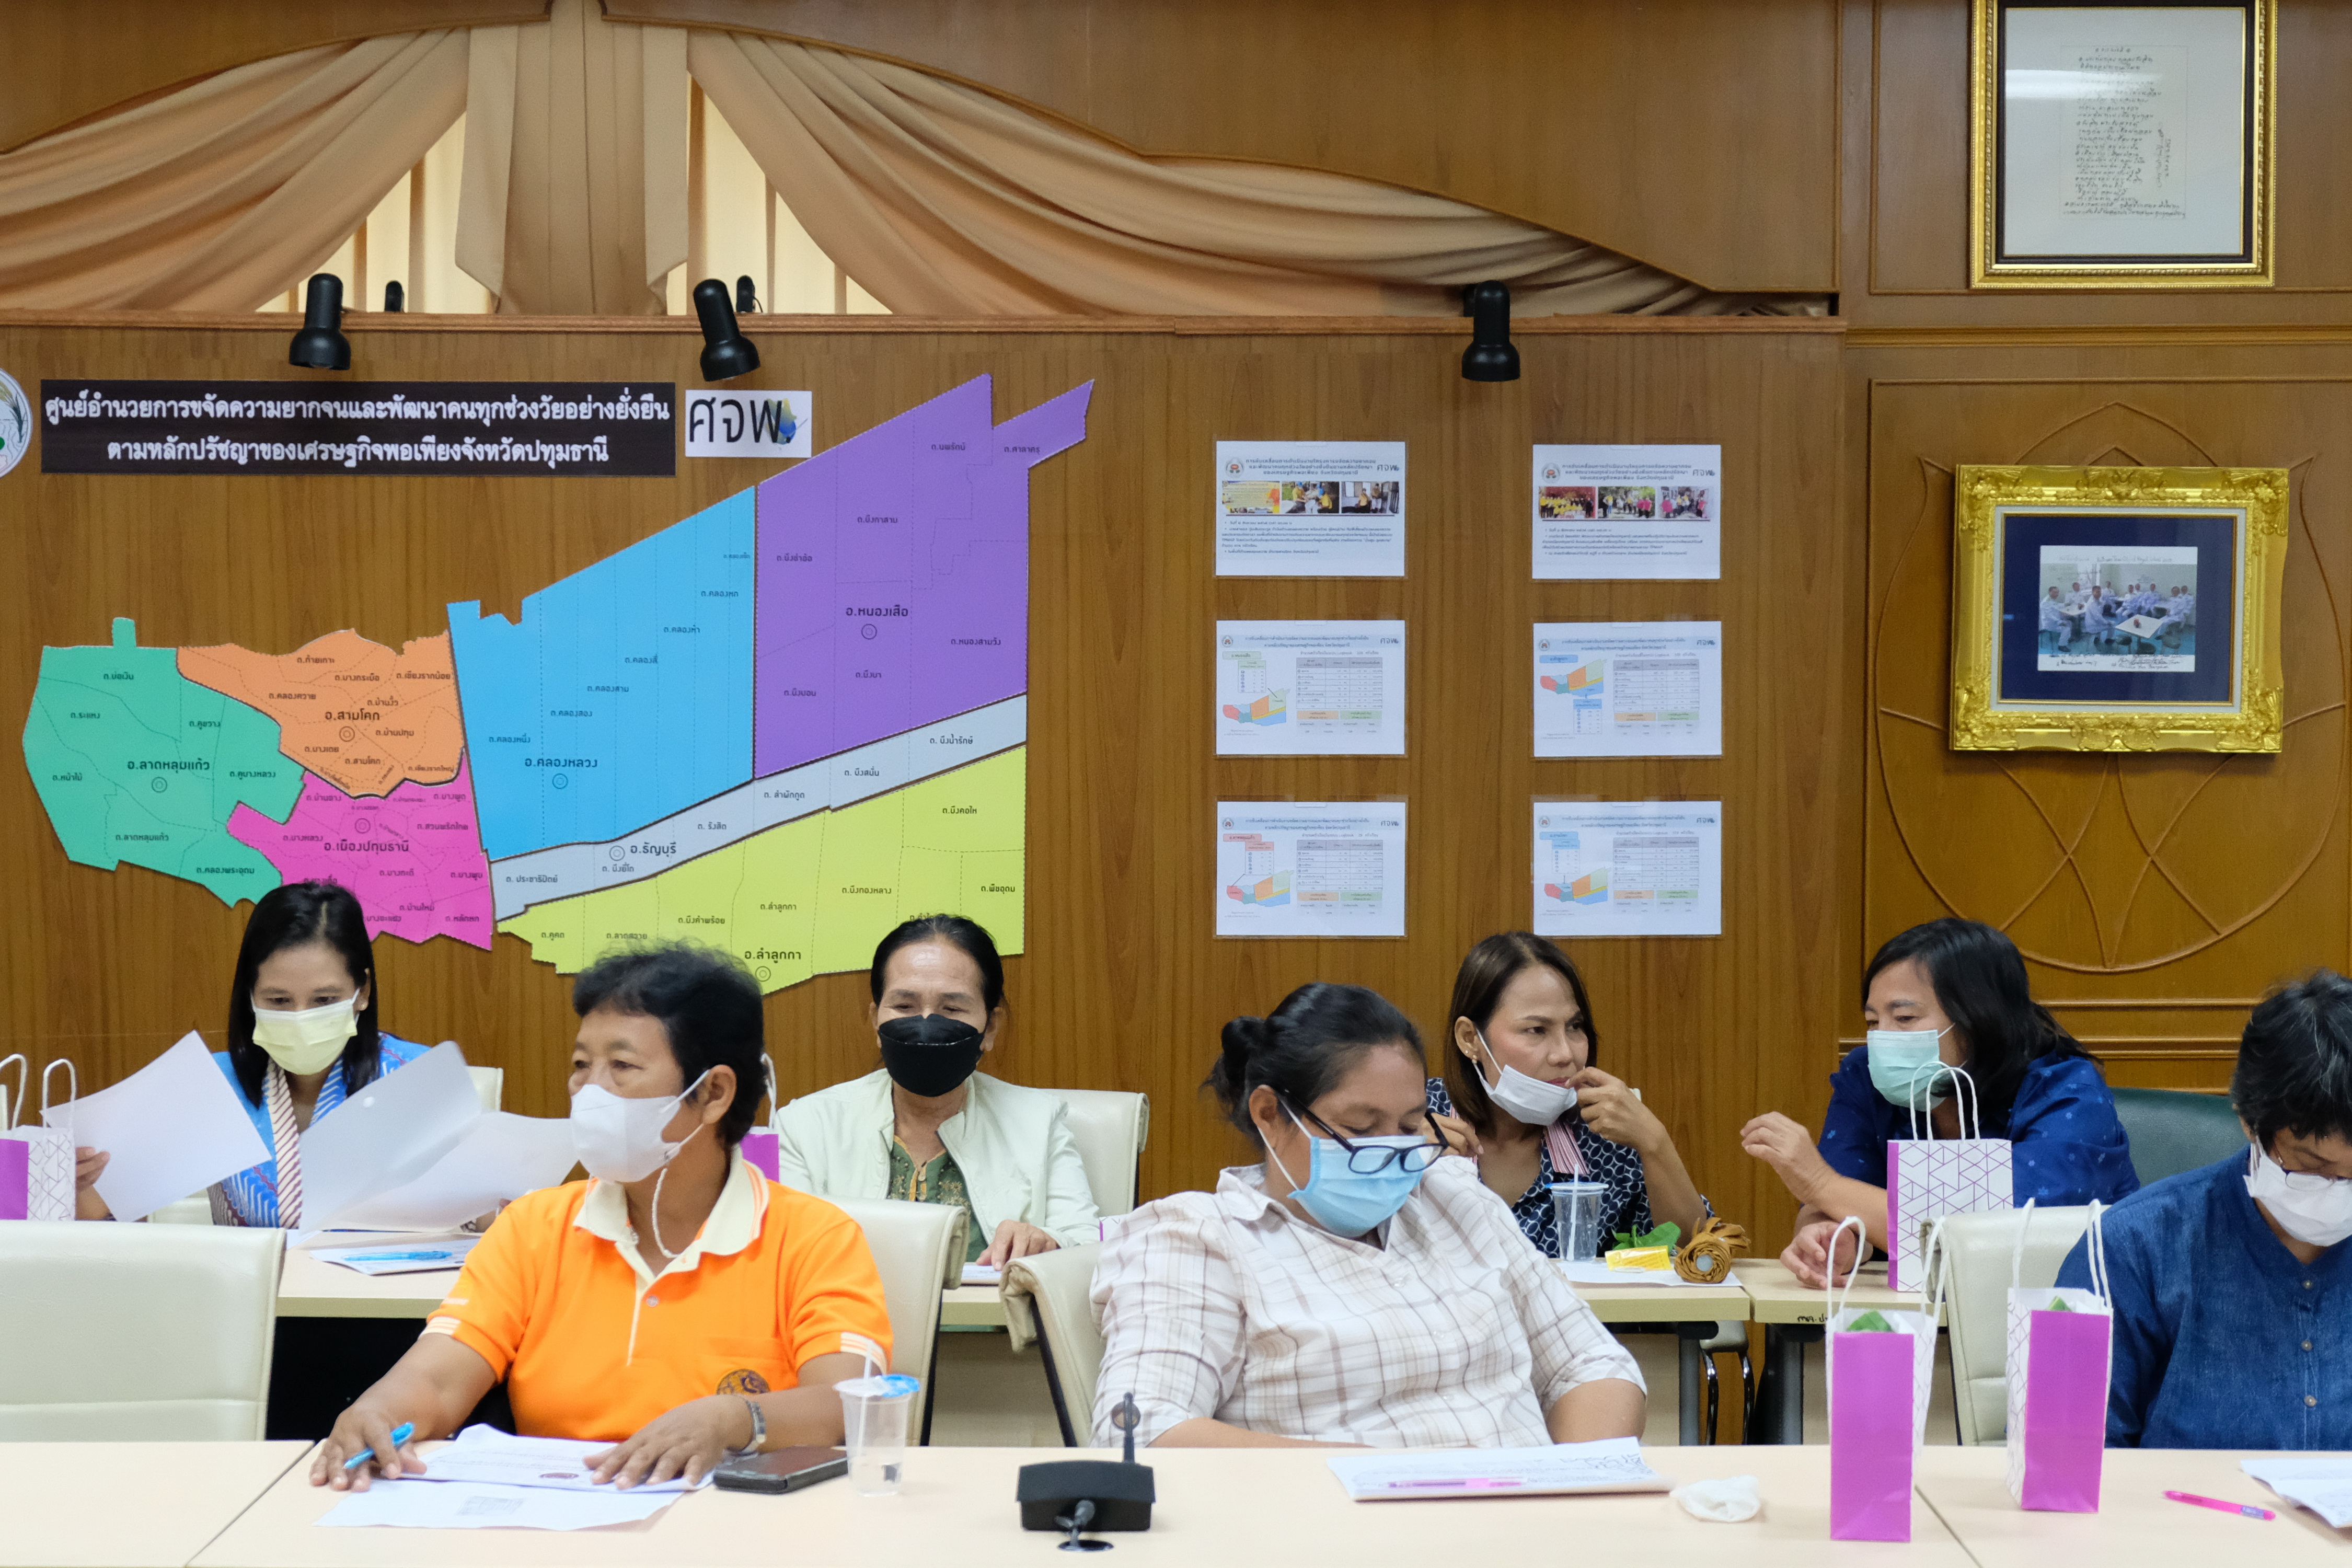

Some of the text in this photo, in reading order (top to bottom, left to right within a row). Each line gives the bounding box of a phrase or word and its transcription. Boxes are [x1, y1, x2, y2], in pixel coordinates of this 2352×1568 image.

[846, 605, 908, 617] อ.หนองเสือ
[325, 709, 379, 721] อ.สามโคก
[127, 758, 210, 773] อ.ลาดหลุมแก้ว
[525, 757, 598, 768] อ.คลองหลวง
[324, 839, 409, 855] อ.เมืองปทุมธานี
[630, 841, 677, 858] อ.ธัญบุรี
[744, 947, 801, 963] อ.ลำลูกกา
